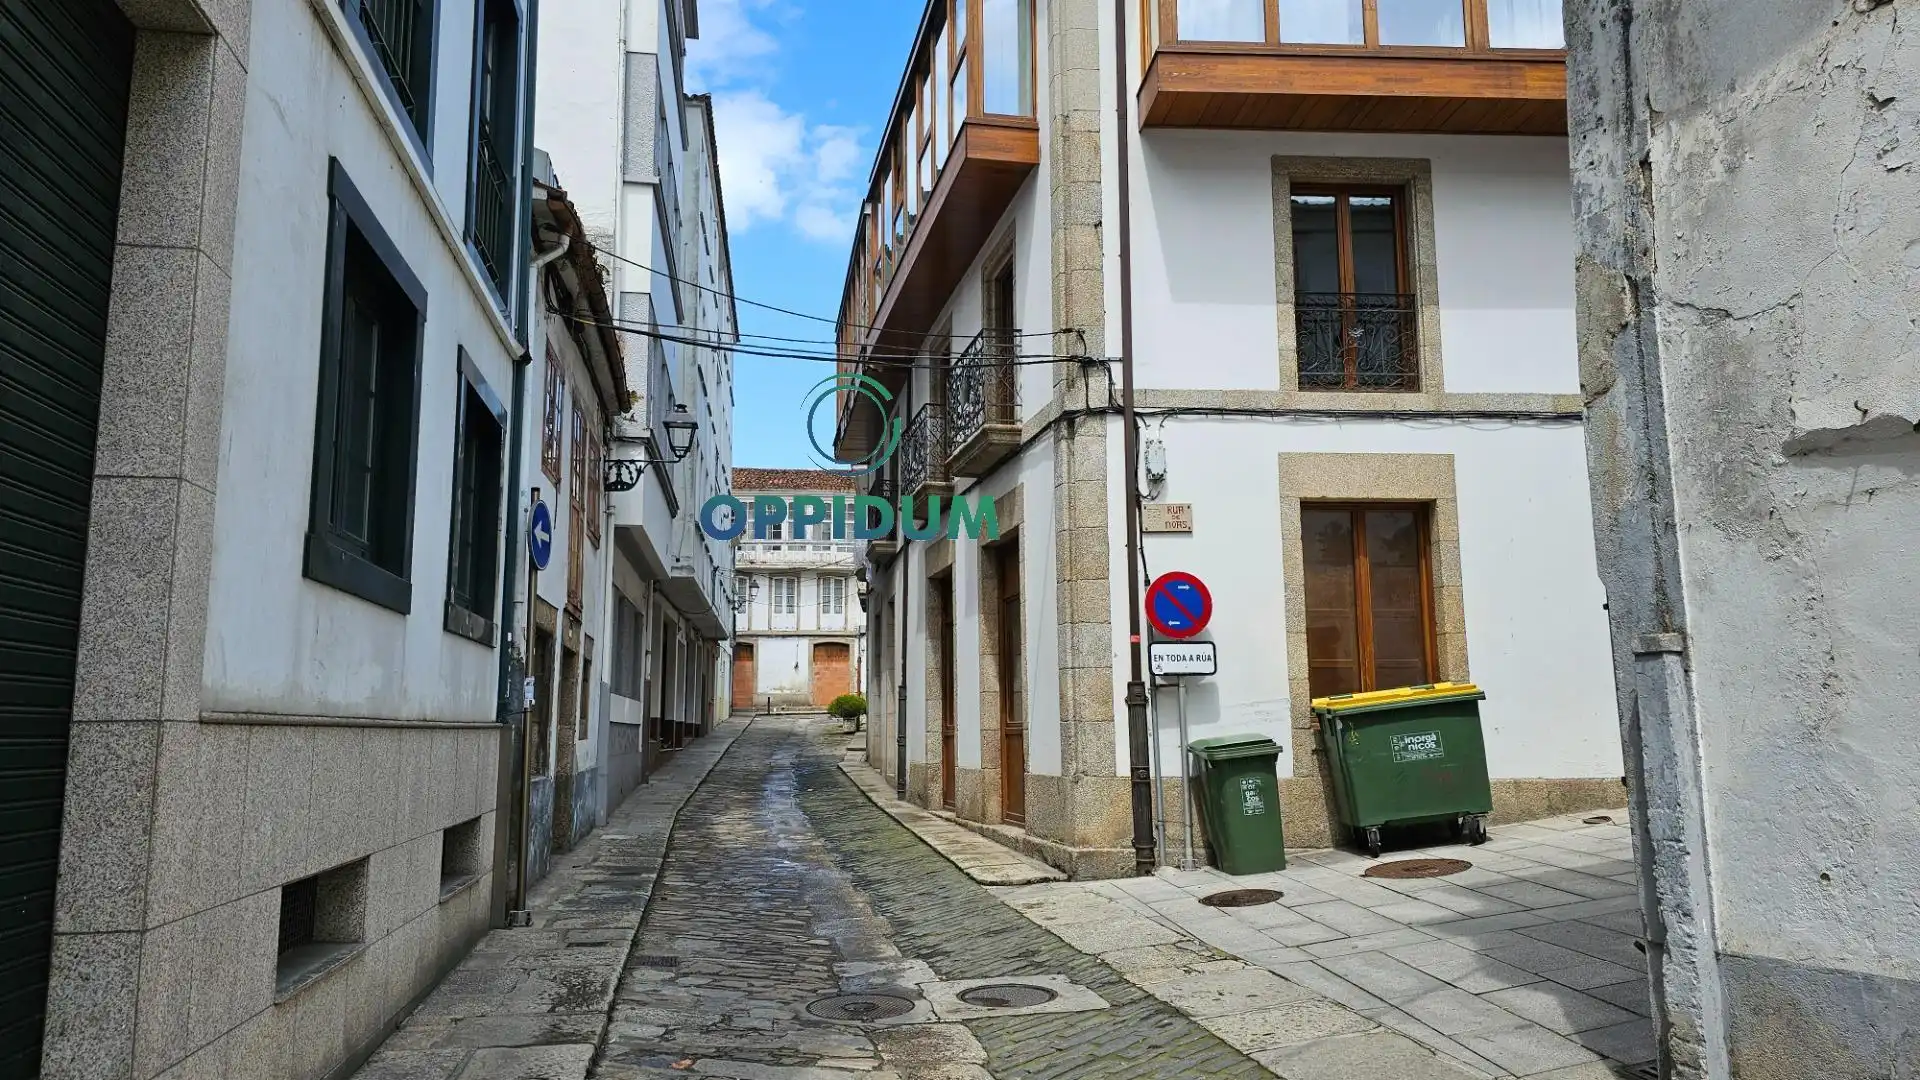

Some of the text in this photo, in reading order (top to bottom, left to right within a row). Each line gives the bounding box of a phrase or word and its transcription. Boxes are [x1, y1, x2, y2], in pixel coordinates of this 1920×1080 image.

[1153, 651, 1213, 662] EN TODA A RÚA
[1404, 732, 1437, 744] inorgá
[1408, 742, 1436, 750] nicos
